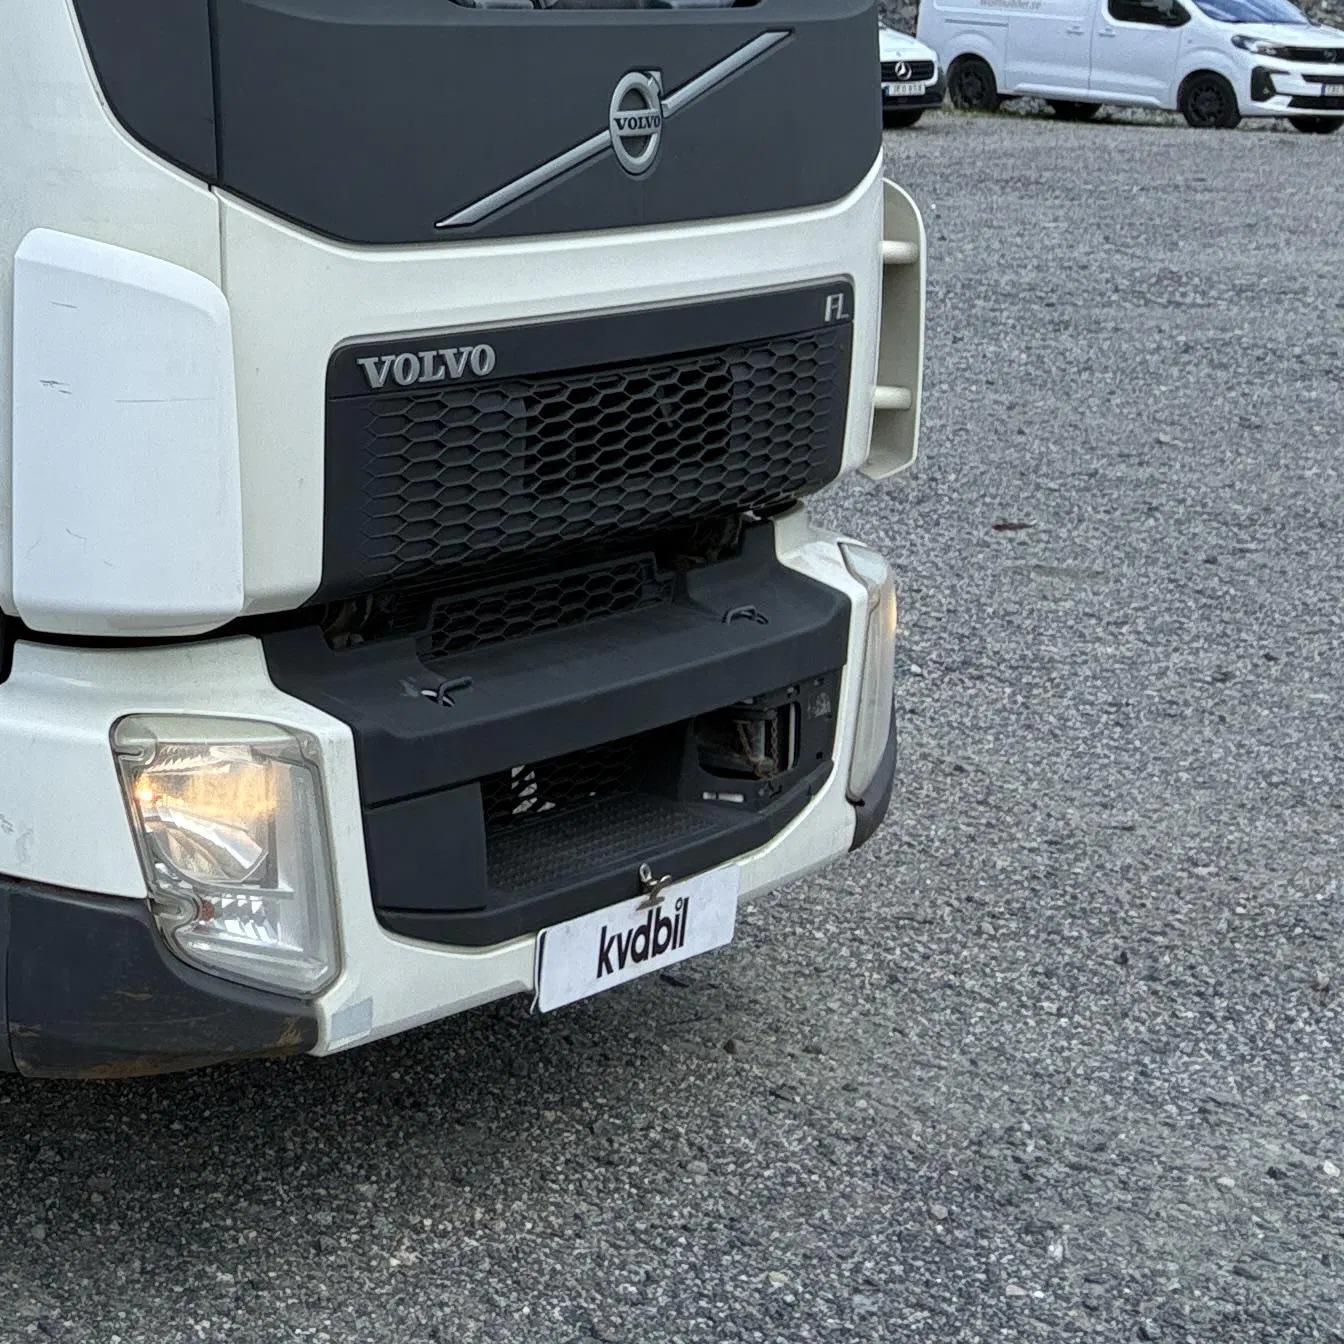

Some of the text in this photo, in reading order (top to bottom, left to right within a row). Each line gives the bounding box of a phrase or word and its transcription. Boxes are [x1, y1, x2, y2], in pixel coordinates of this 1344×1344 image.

[613, 115, 661, 130] VOLVO
[824, 292, 850, 322] FL
[357, 343, 496, 389] VOLVO
[596, 896, 690, 979] kvdbil
